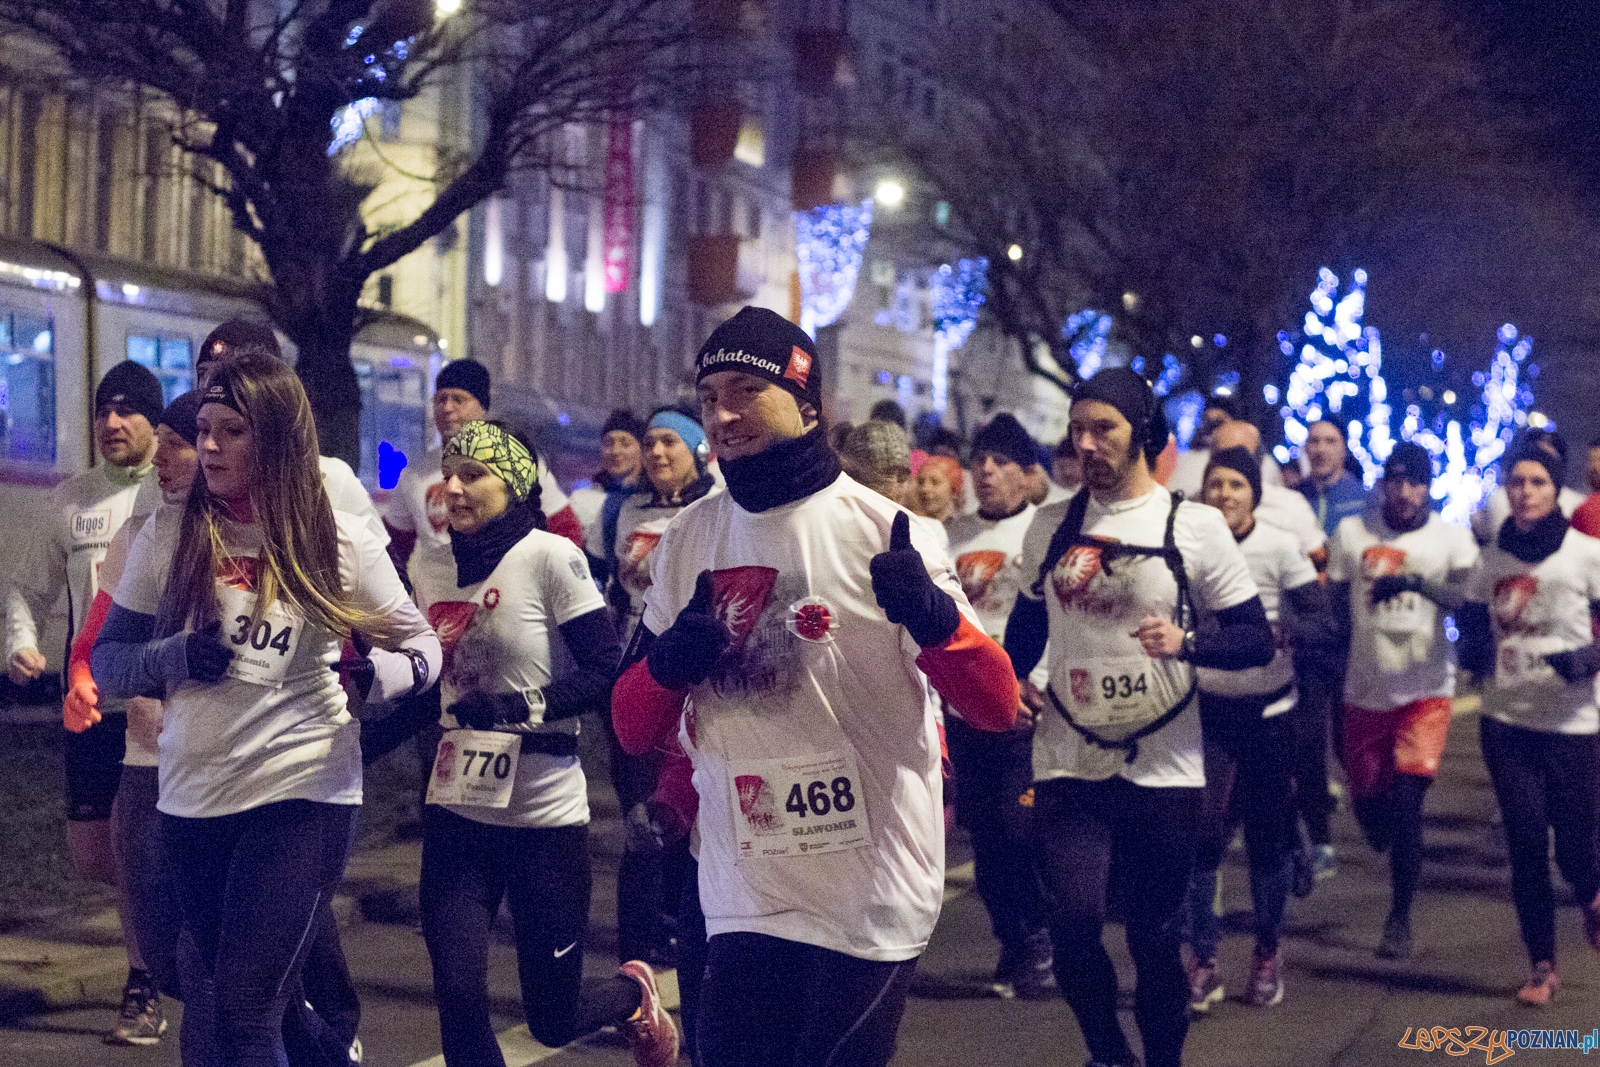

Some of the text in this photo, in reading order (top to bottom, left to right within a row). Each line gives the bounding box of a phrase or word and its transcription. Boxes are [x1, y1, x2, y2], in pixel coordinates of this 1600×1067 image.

[702, 348, 781, 375] bohaterom
[76, 516, 104, 535] Argos
[230, 614, 293, 656] 304
[1101, 673, 1148, 699] 934
[462, 749, 511, 780] 770
[785, 776, 856, 818] 468
